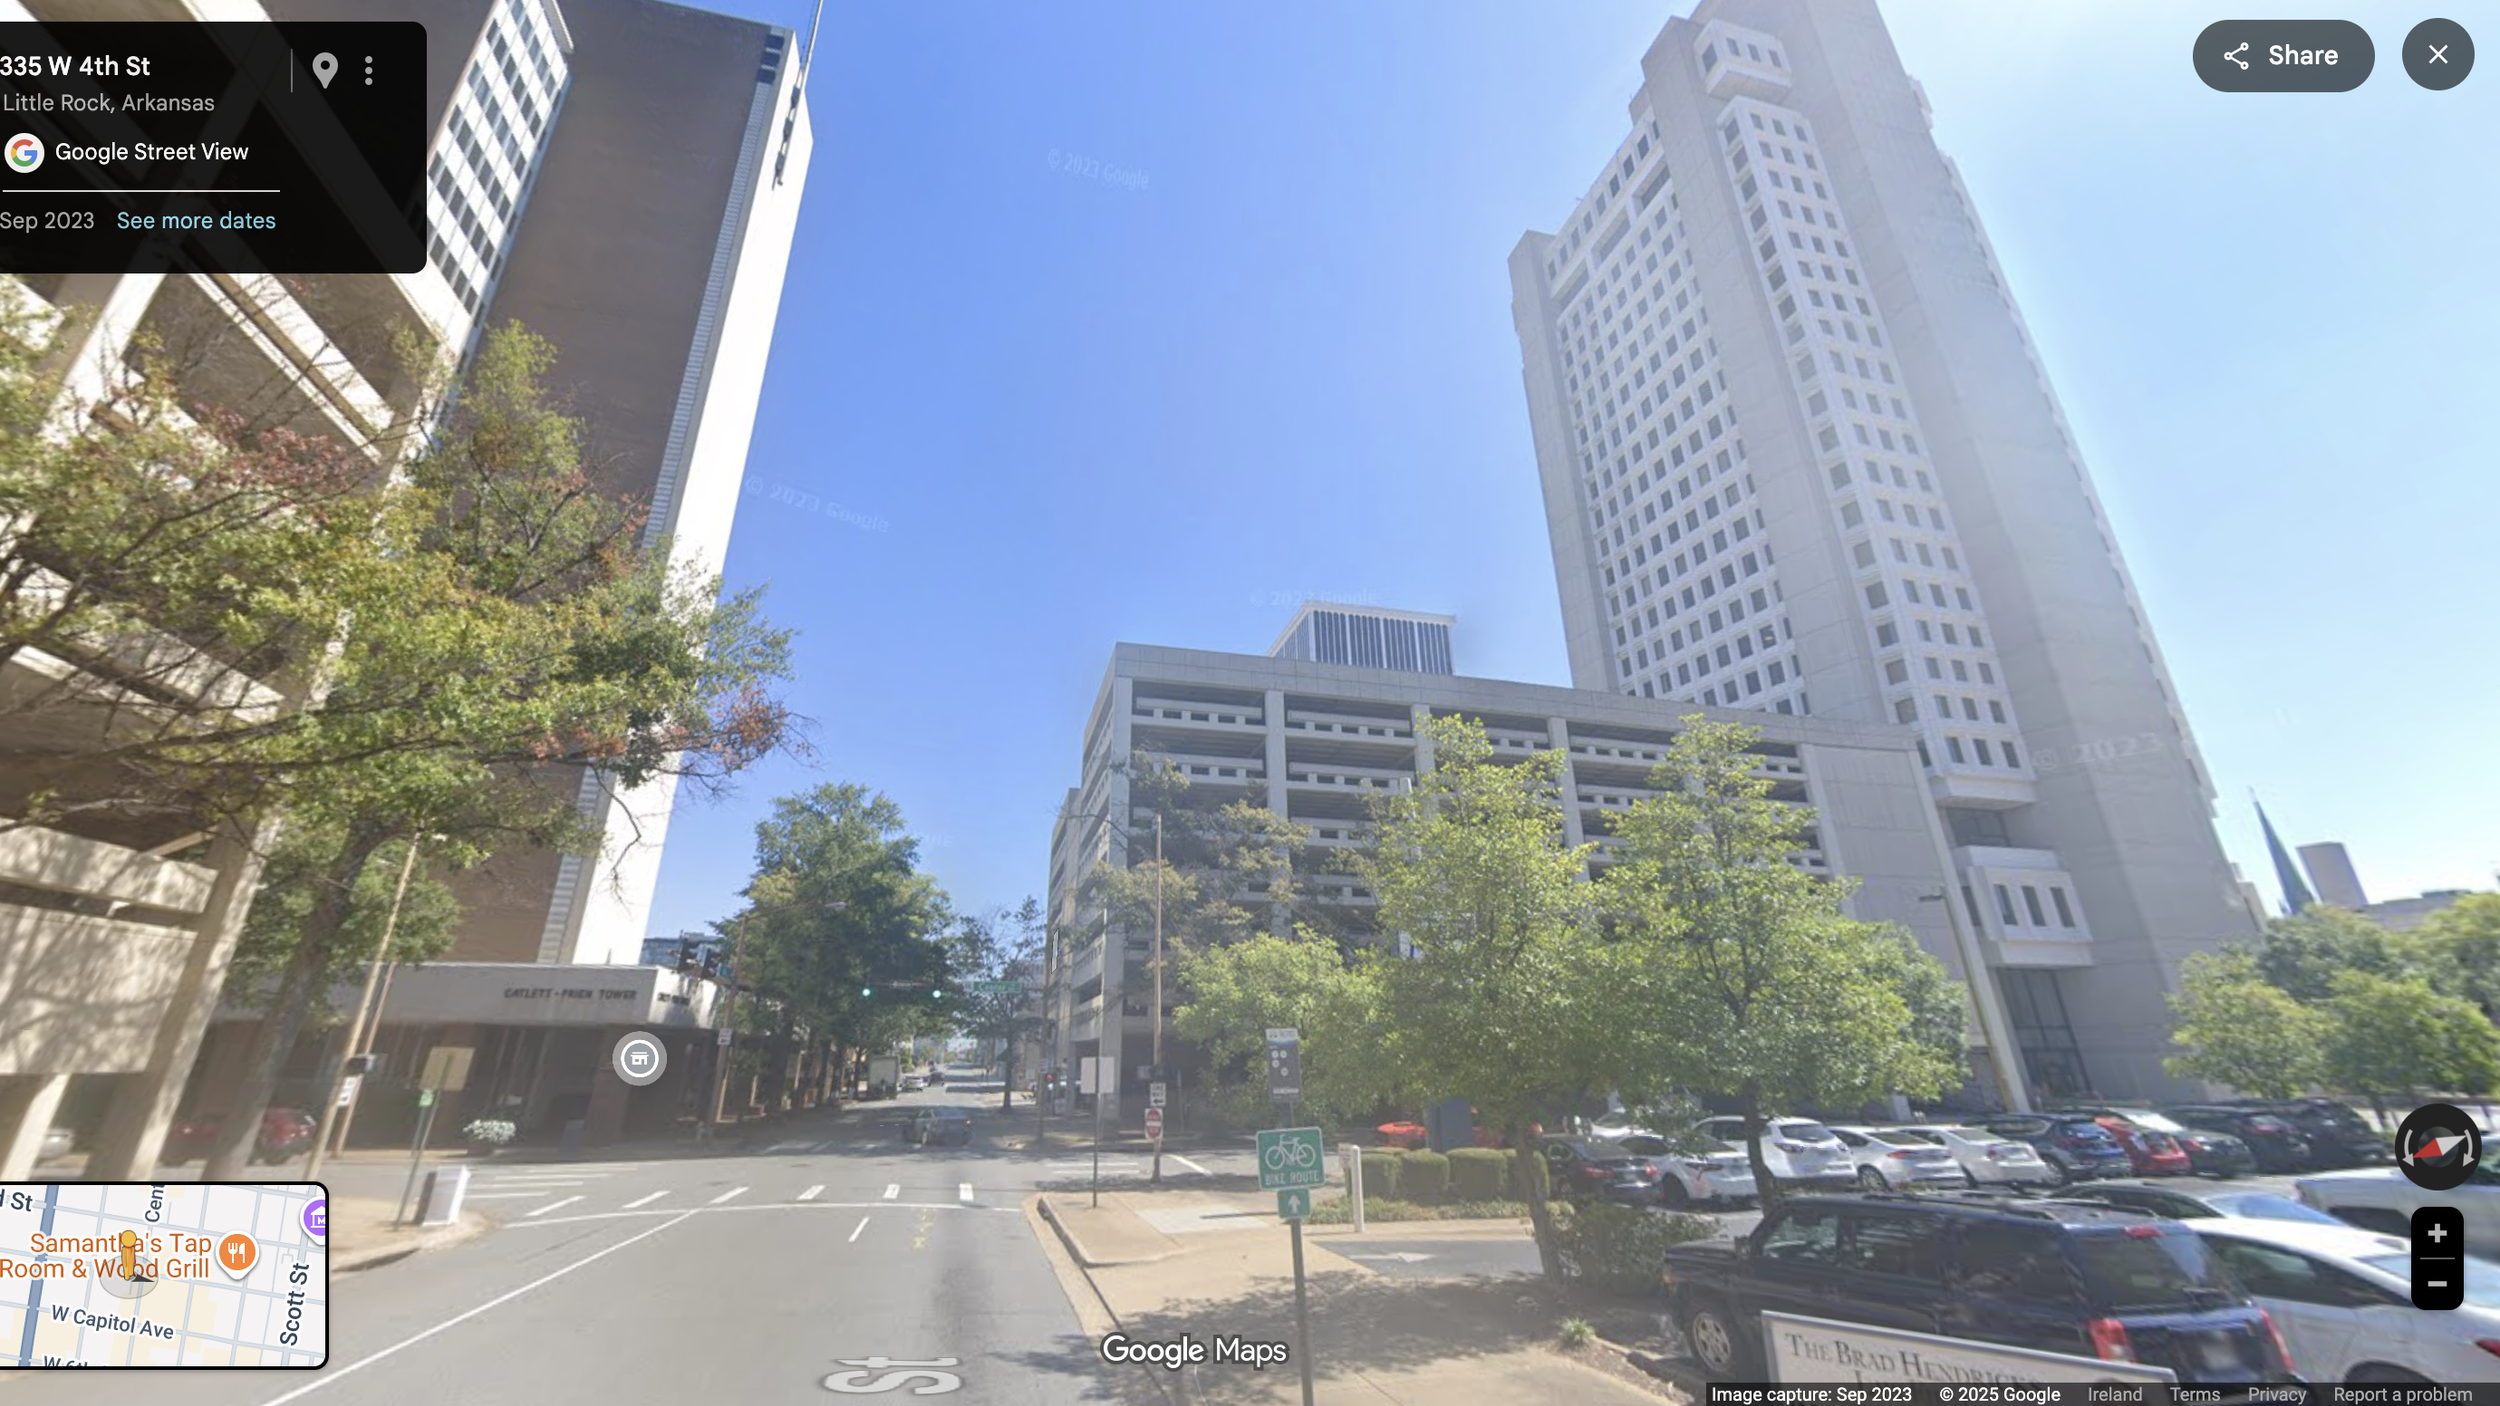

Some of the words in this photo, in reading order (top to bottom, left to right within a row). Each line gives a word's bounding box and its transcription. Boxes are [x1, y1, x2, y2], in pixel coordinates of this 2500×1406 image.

[599, 989, 637, 1000] TOWER
[1265, 1172, 1286, 1186] BIKE
[1290, 1169, 1320, 1184] ROUTE
[1785, 1333, 1833, 1361] THE
[1835, 1340, 1895, 1373] BRAD
[824, 1356, 961, 1395] St
